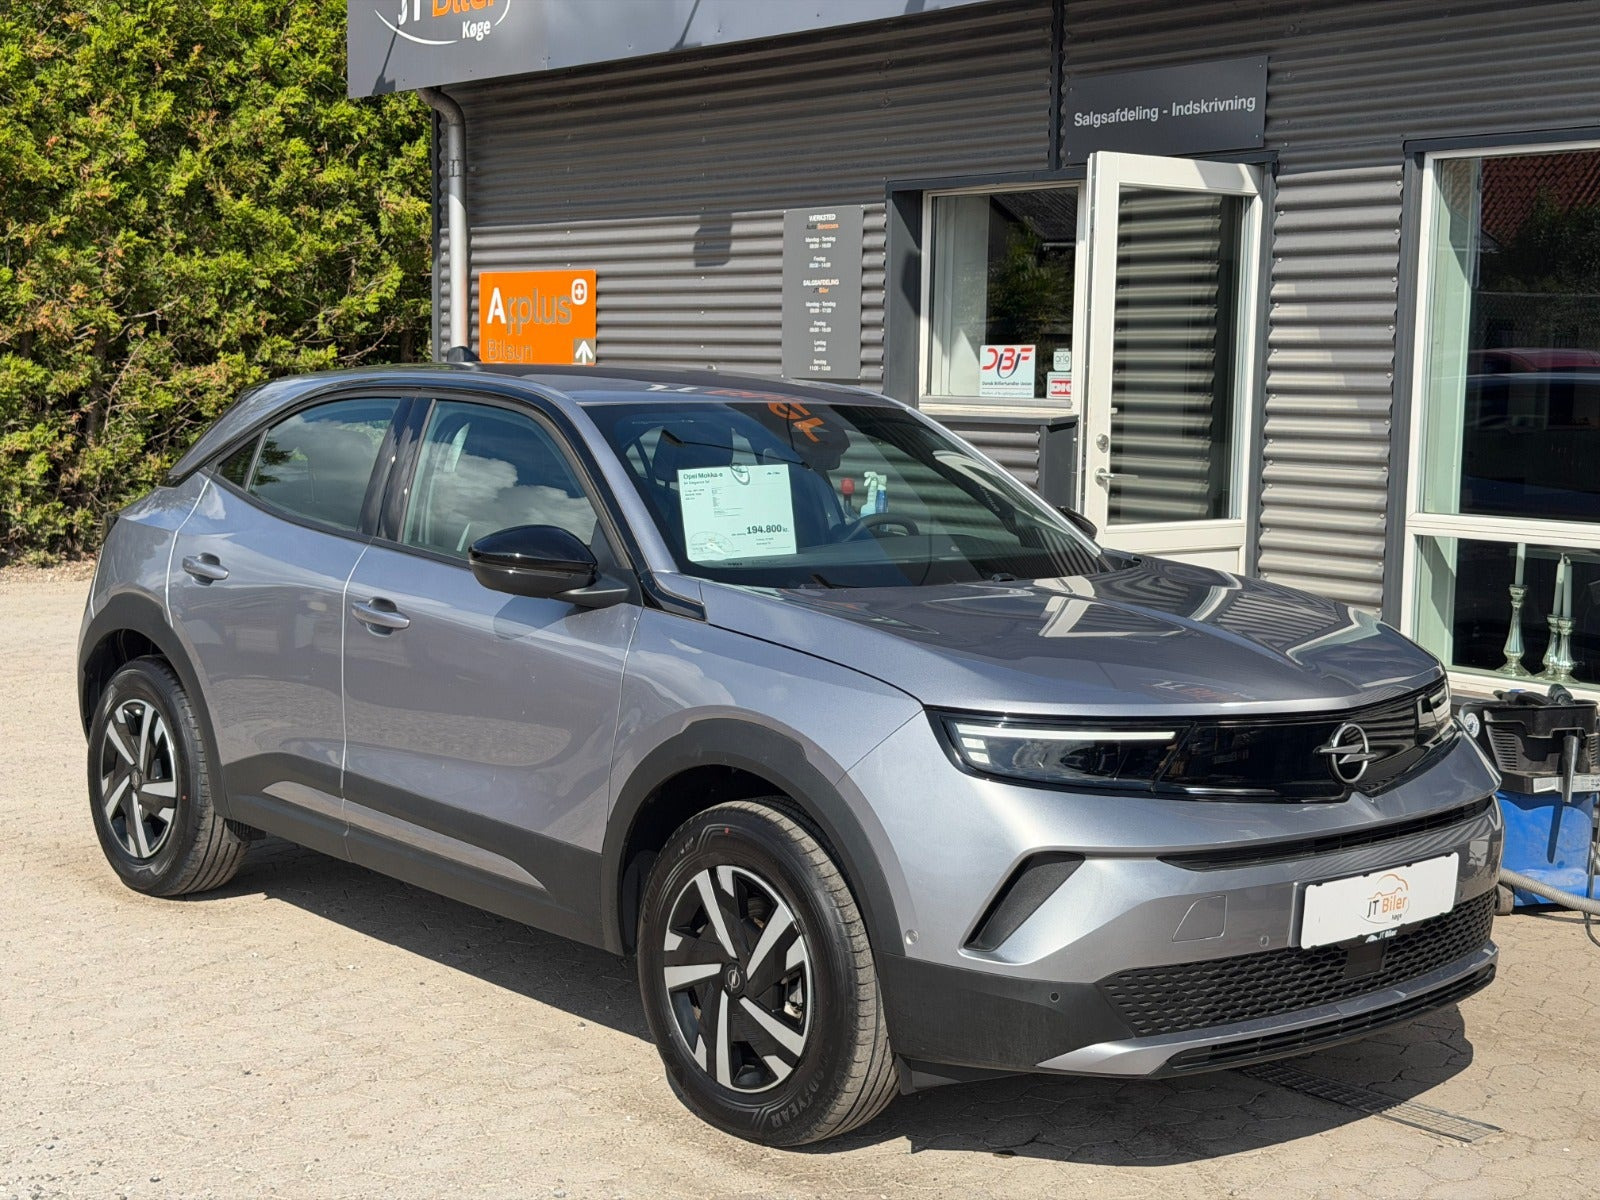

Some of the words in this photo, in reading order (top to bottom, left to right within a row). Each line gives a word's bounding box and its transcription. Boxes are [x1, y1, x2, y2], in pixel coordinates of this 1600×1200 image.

[462, 20, 491, 41] Køge
[1074, 106, 1159, 128] Salgsafdeling
[1172, 95, 1256, 117] Indskrivning
[746, 524, 782, 535] 194.800
[1381, 896, 1407, 913] Biler
